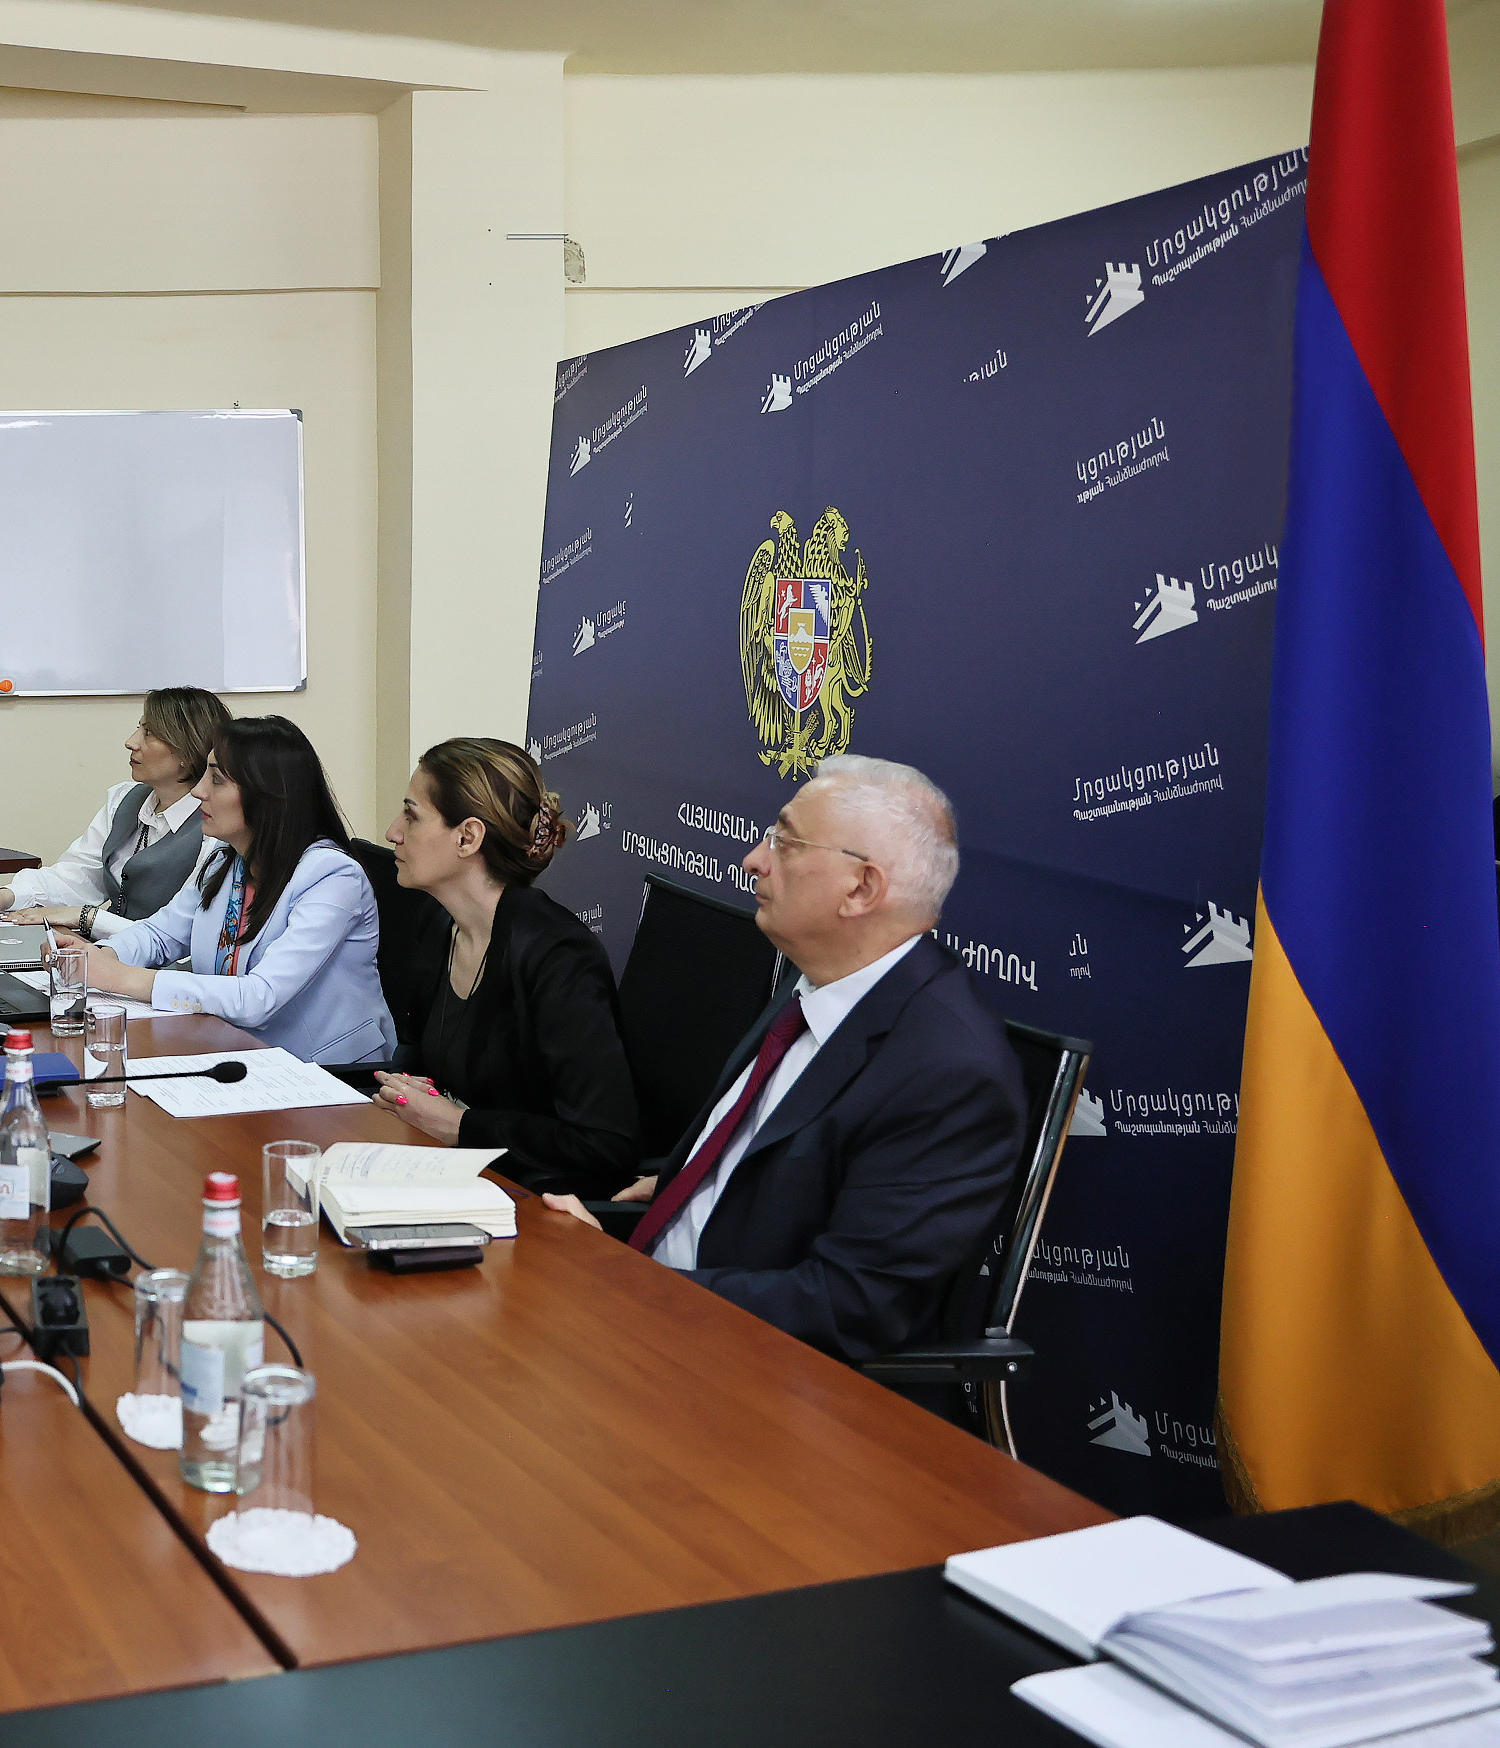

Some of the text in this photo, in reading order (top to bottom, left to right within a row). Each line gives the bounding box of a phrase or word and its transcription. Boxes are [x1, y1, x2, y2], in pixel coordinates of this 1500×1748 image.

[794, 300, 881, 380] Մրցակցության
[963, 349, 1008, 383] թյան
[592, 385, 648, 442] Մրցակցության
[1076, 416, 1166, 484] կցության
[677, 802, 759, 844] ՀԱՅԱՍՏԱՆԻ
[622, 830, 723, 883] ՄՐՑԱԿՑՈՒԹՅԱՆ
